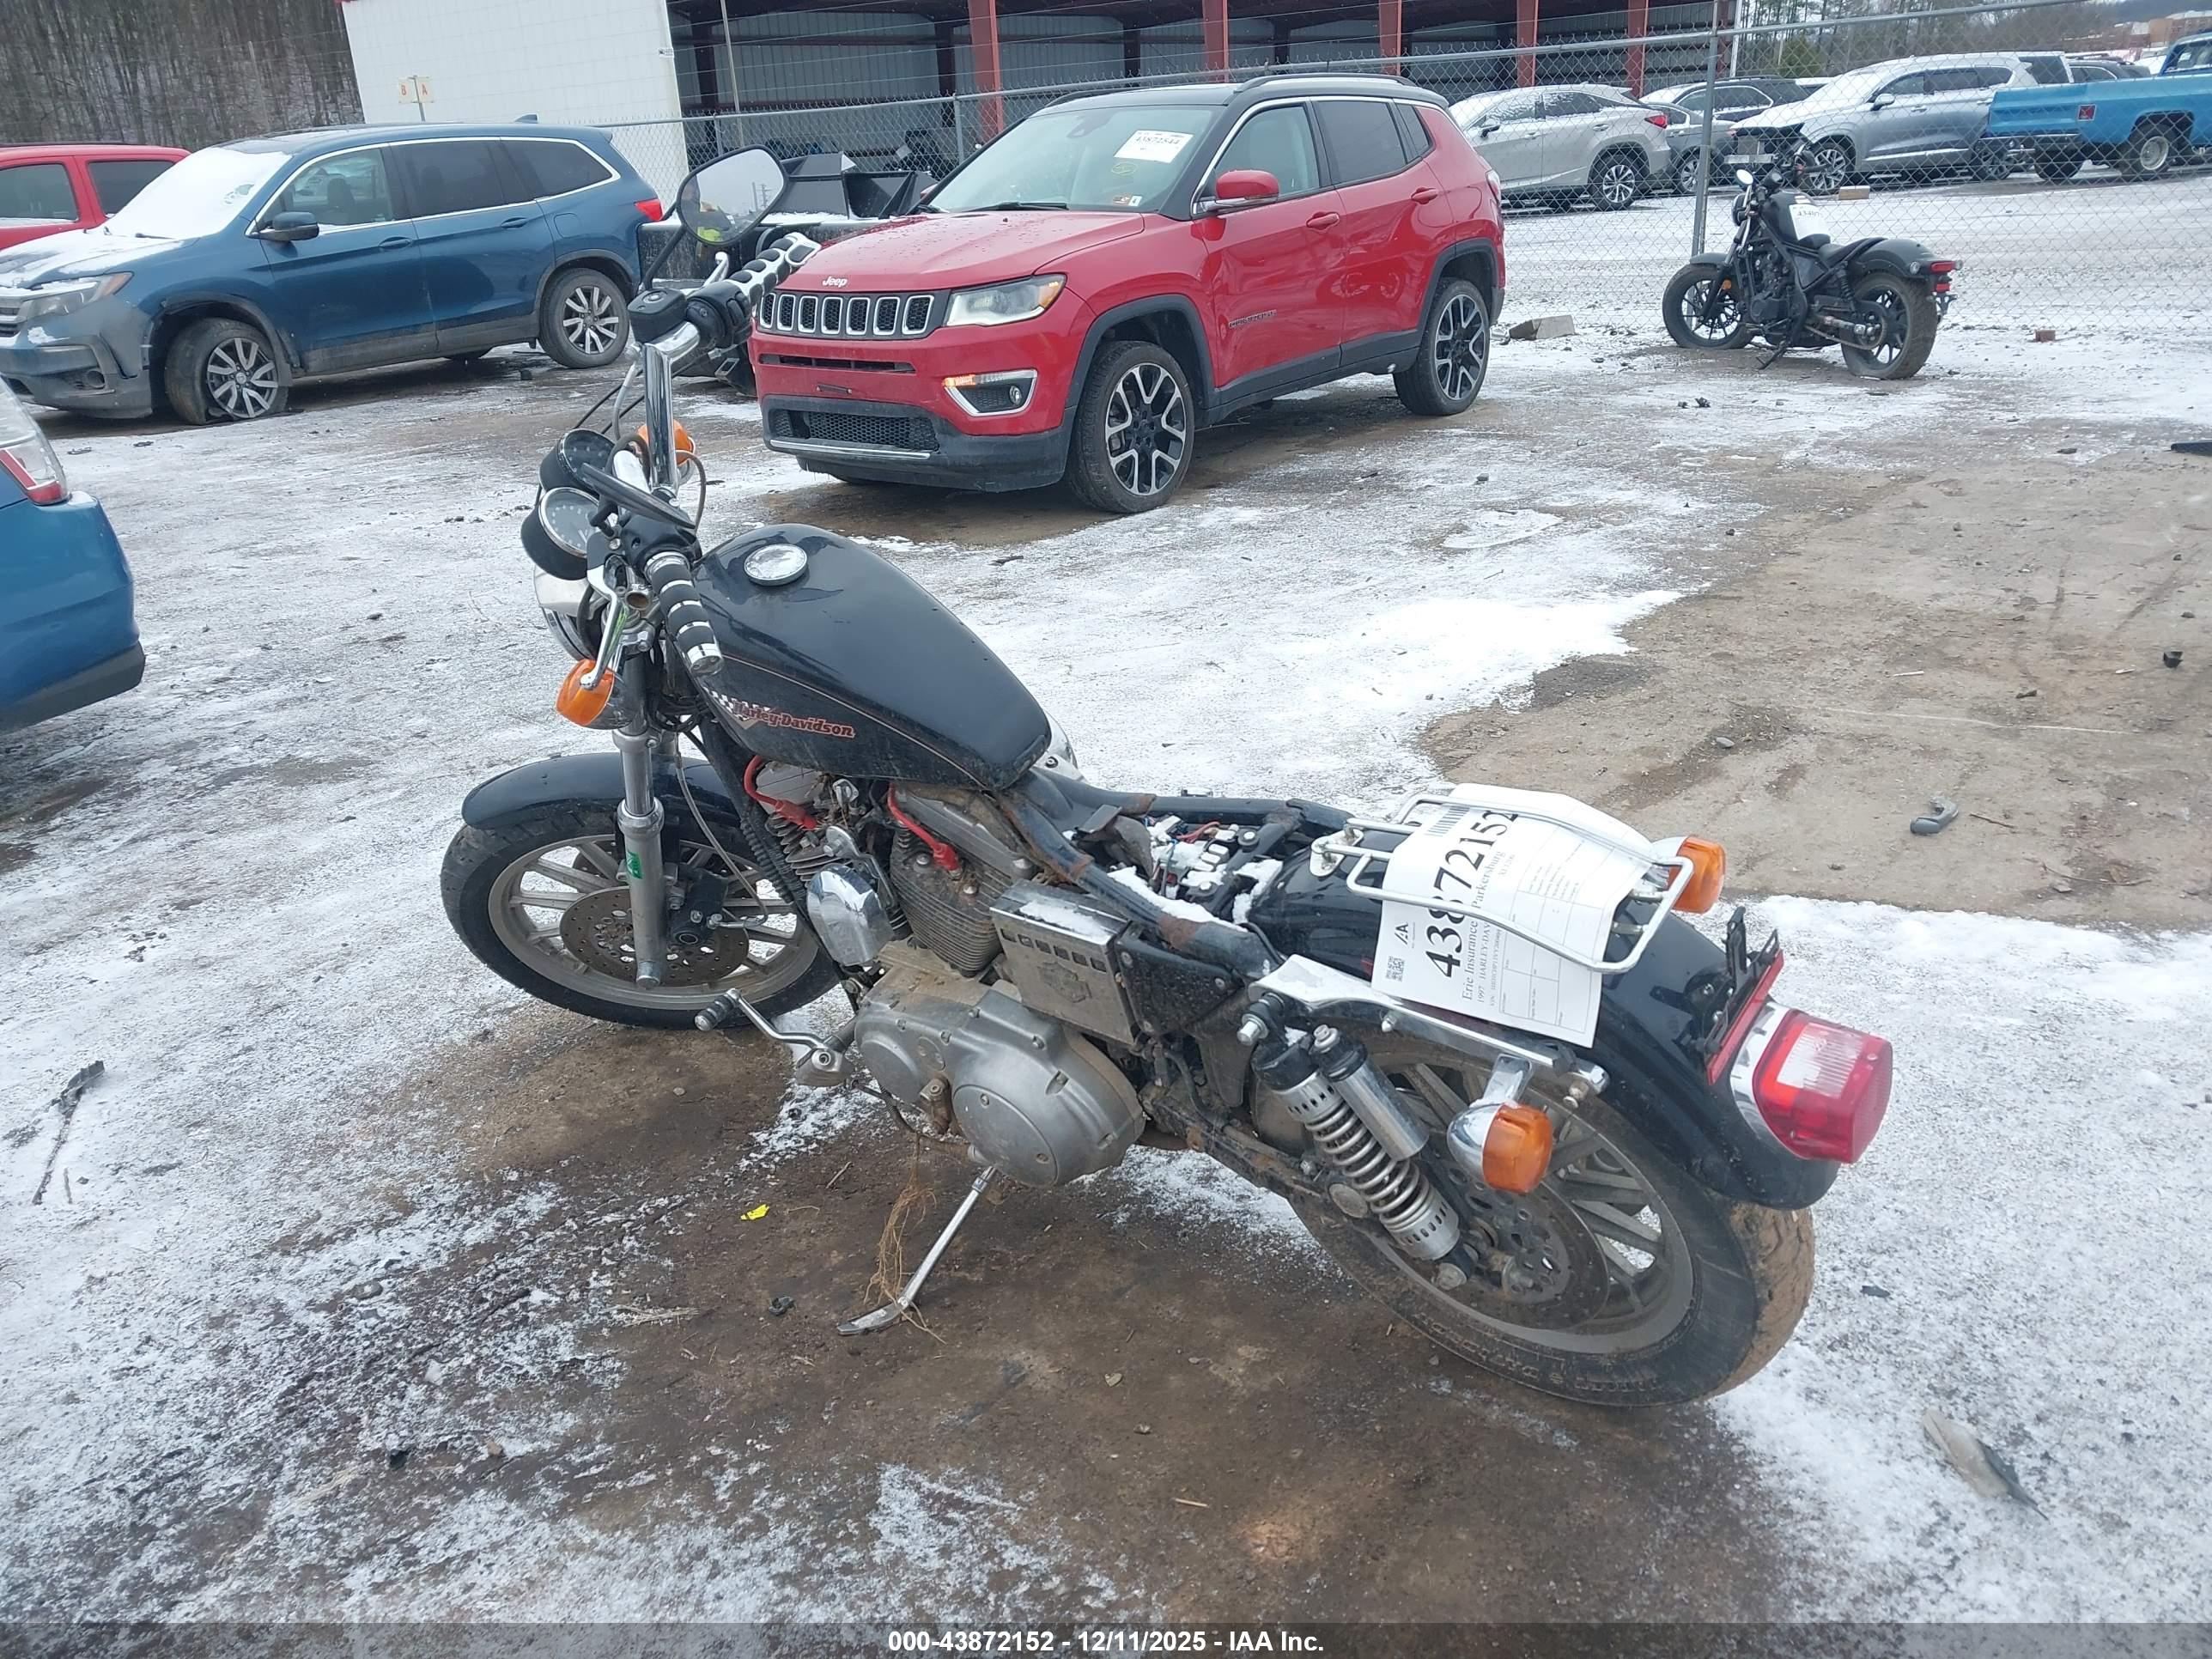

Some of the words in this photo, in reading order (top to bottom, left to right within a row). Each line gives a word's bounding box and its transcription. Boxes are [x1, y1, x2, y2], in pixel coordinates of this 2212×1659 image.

[421, 83, 428, 96] A
[822, 276, 848, 288] Jeep
[732, 700, 857, 739] Harley-Davidson
[1471, 851, 1506, 909] Parkersburg
[1464, 921, 1479, 975] Insurance
[1462, 977, 1474, 1000] Erie
